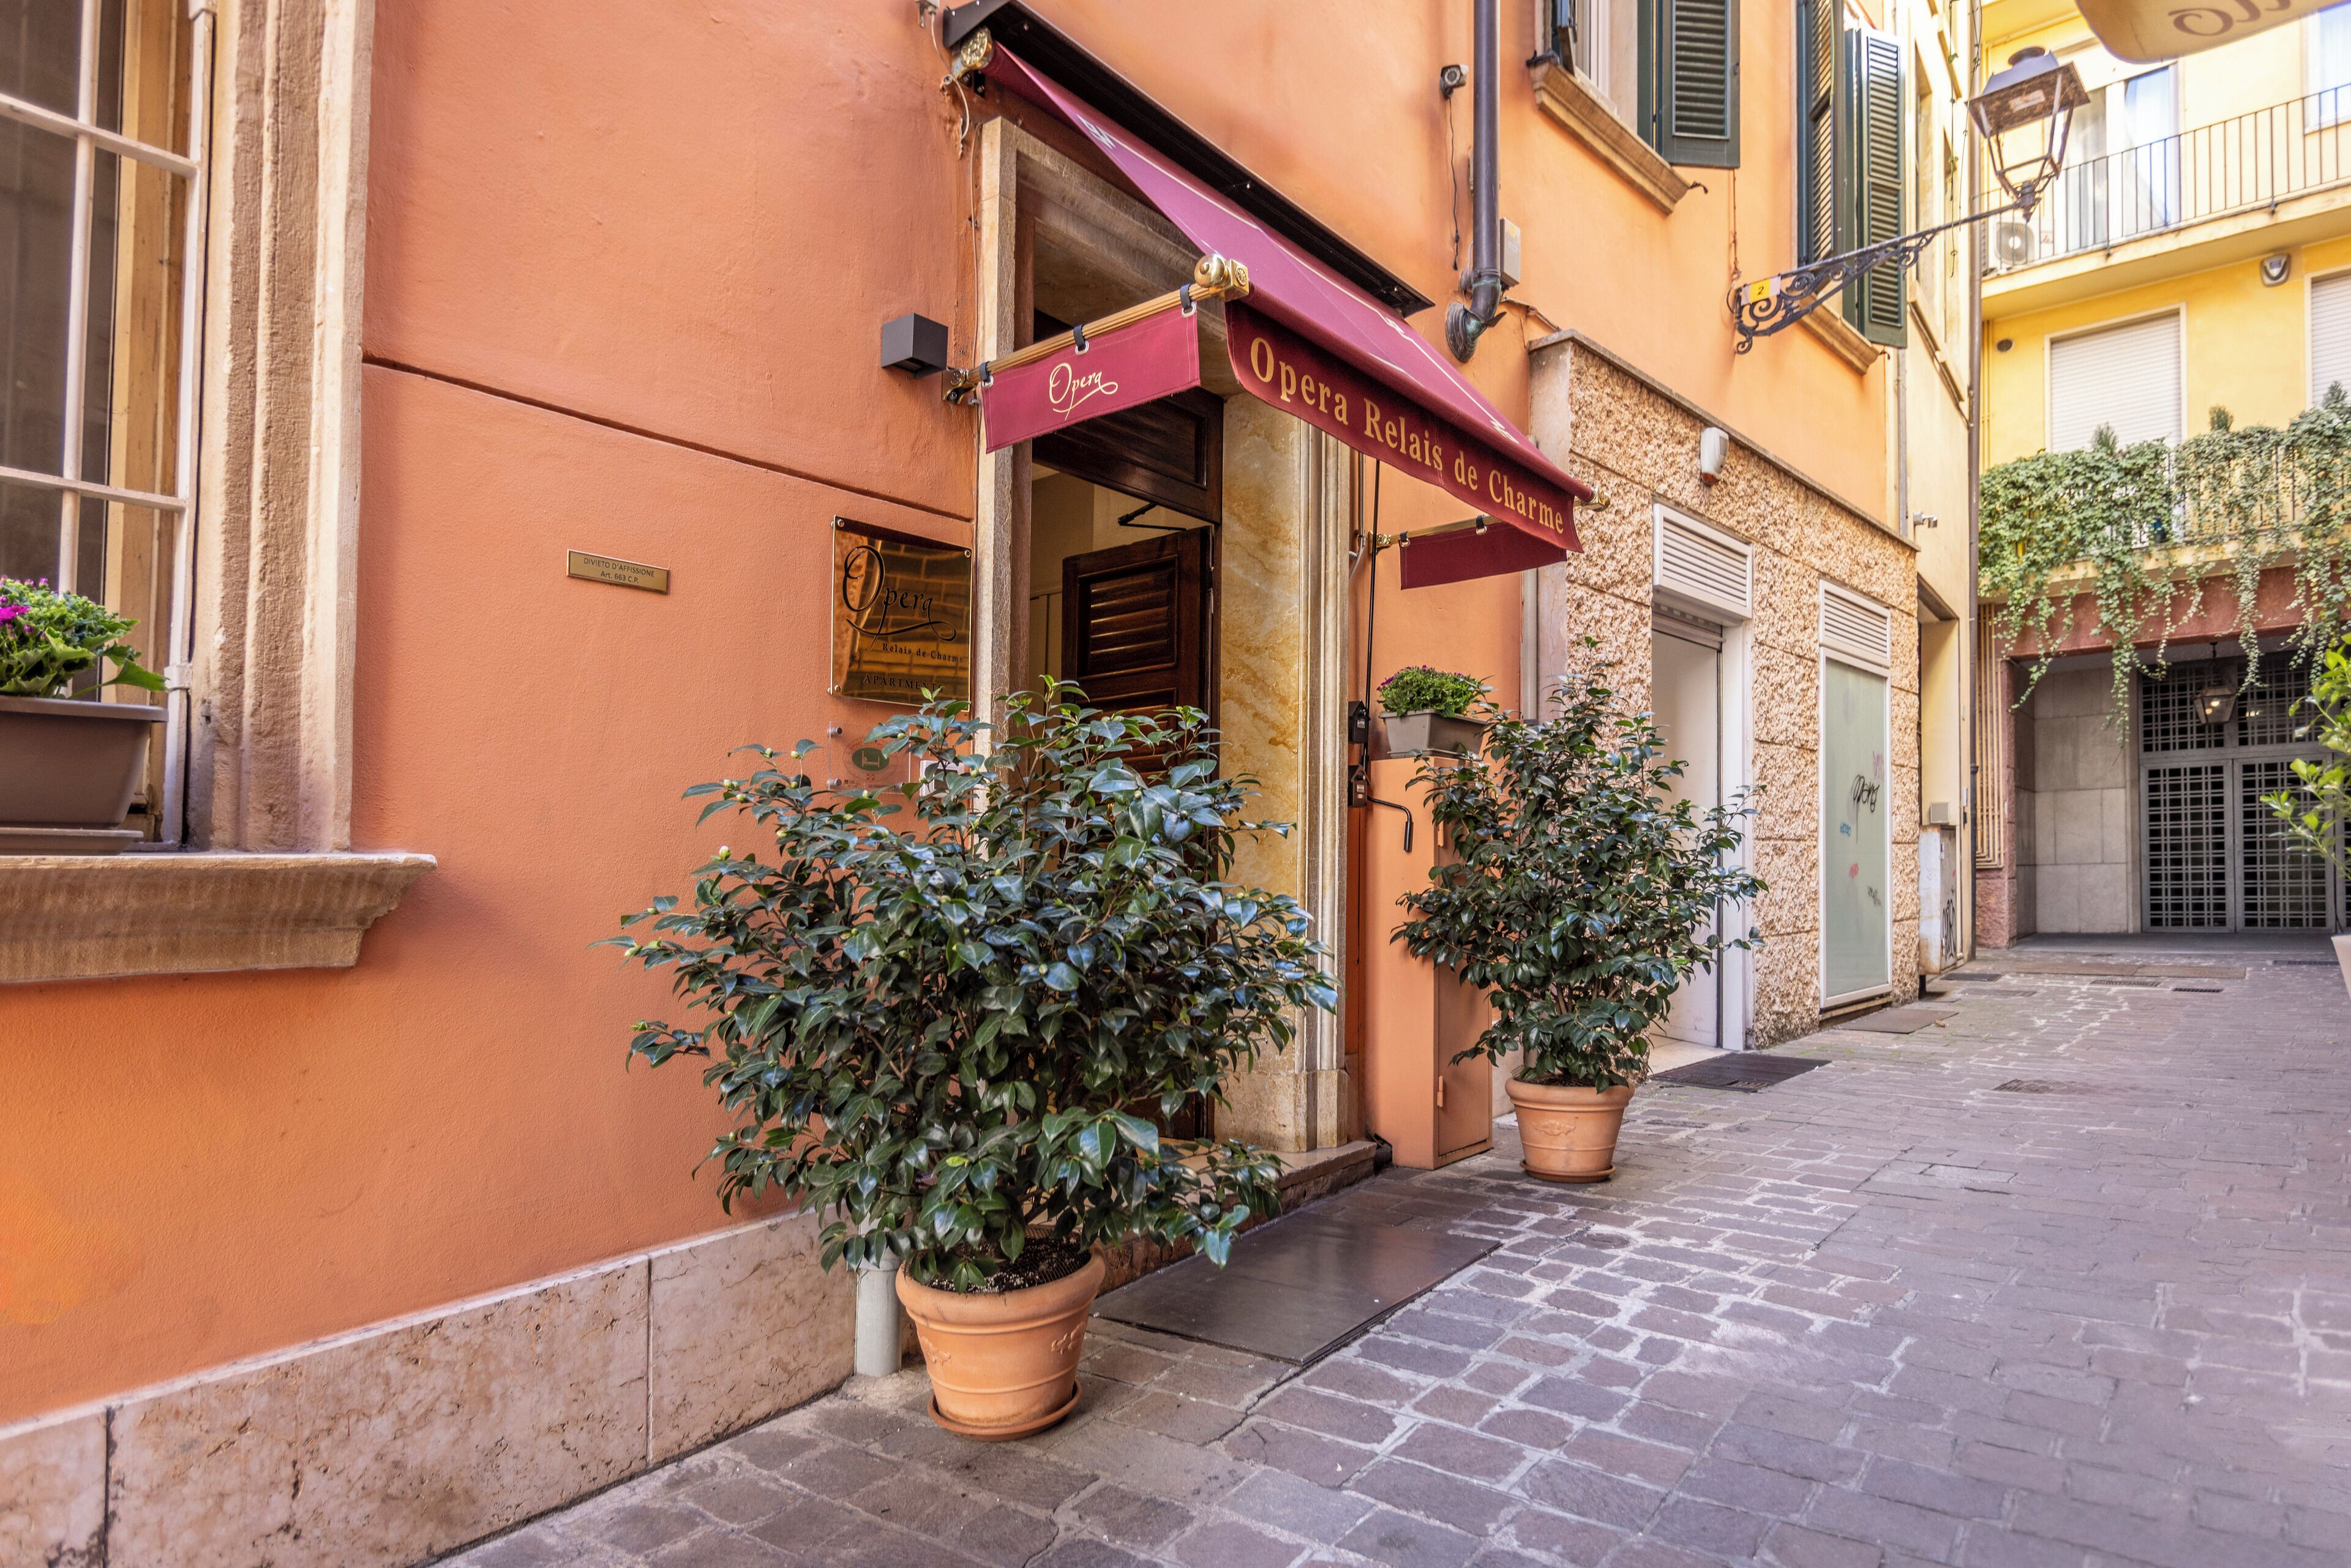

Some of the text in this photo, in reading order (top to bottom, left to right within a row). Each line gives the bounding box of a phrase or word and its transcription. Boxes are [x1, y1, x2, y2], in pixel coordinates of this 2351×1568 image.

[1757, 286, 1764, 295] 2
[1049, 362, 1119, 421] Opera
[1250, 336, 1564, 535] Opera Relais de Charme
[584, 558, 654, 577] DIVIETO D'AFFISSIONE
[842, 545, 957, 651] Opera
[882, 643, 965, 662] Relais de Charme
[863, 674, 944, 692] APARTMENTS
